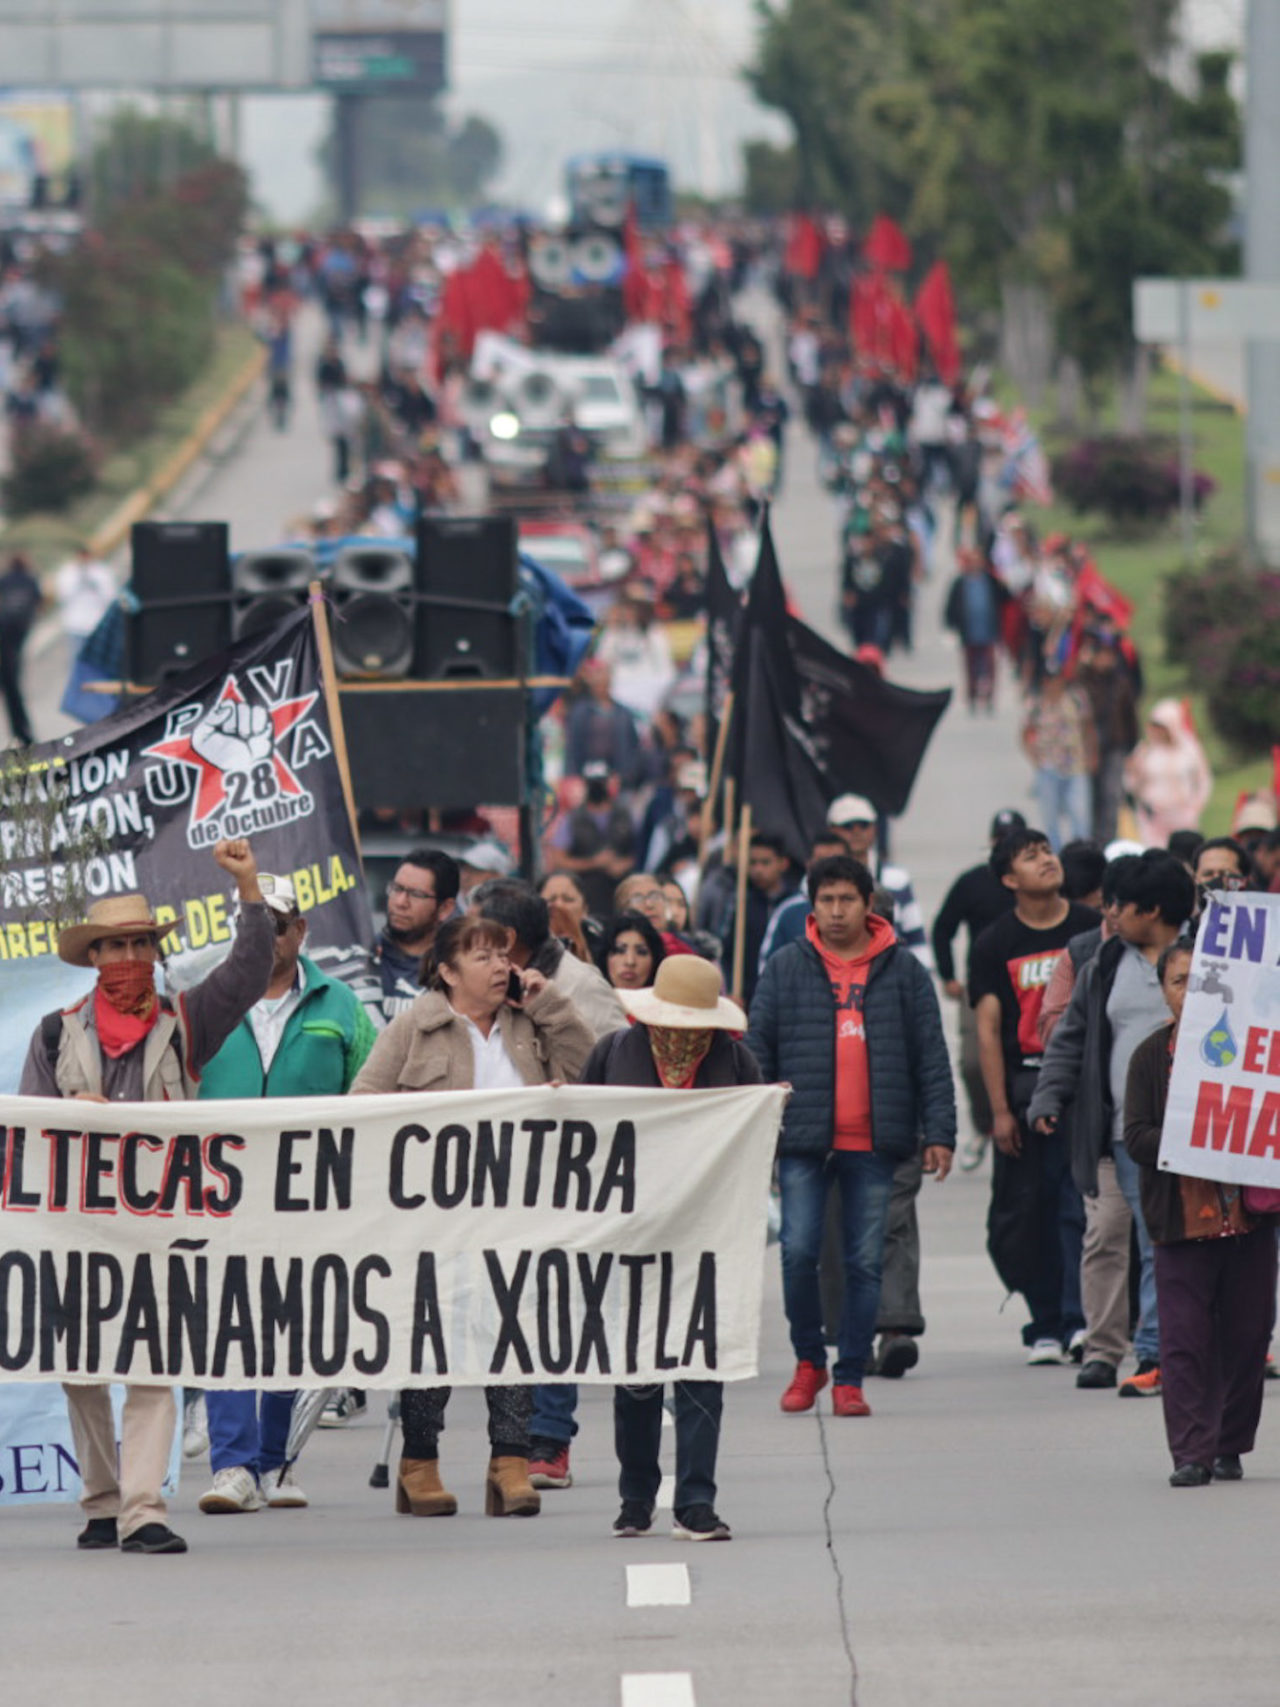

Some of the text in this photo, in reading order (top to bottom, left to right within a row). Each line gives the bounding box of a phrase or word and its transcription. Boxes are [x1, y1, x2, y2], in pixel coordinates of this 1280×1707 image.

[225, 762, 277, 810] 28
[190, 793, 312, 847] de Octubre
[185, 893, 231, 948] DE
[1201, 900, 1267, 963] EN
[274, 1127, 355, 1211] EN
[388, 1120, 637, 1213] CONTRA
[411, 1250, 449, 1375] A
[483, 1248, 717, 1375] XOXTLA
